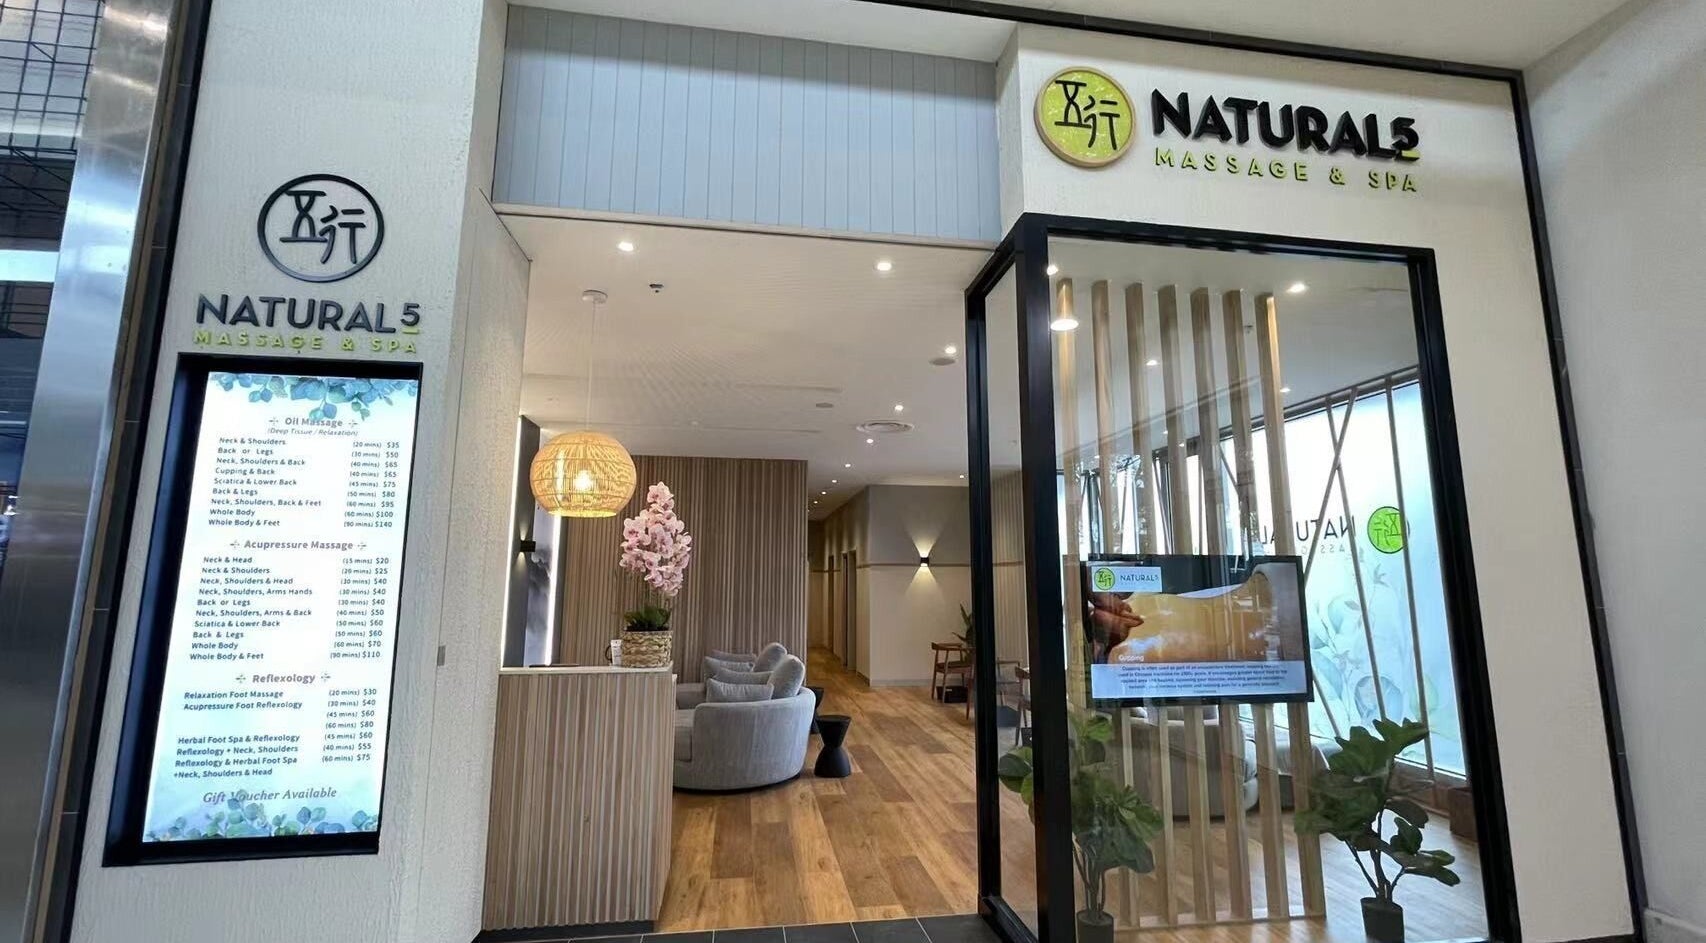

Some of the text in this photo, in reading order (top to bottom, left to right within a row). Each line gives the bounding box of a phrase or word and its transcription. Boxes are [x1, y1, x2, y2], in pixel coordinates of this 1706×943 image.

[1154, 147, 1417, 192] MASSAGE & SPA
[193, 330, 417, 354] MASSAGE & SPA
[285, 417, 343, 428] Oil Massage
[215, 467, 247, 475] Cupping
[244, 541, 353, 550] Acupressure Massage
[252, 674, 315, 684] Reflexology
[255, 701, 302, 709] Reflexology
[360, 720, 374, 728] $80
[228, 735, 243, 743] Spa
[252, 734, 299, 742] Reflexology
[358, 731, 373, 739] $60
[357, 742, 371, 750] $55
[176, 747, 224, 757] Reflexology
[257, 745, 298, 753] Shoulders
[356, 753, 370, 761] $75
[175, 758, 222, 768] Reflexology
[232, 757, 260, 765] Herbal
[282, 756, 297, 764] Spa
[202, 769, 242, 777] Shoulders
[203, 786, 337, 804] Gift Voucher Available
